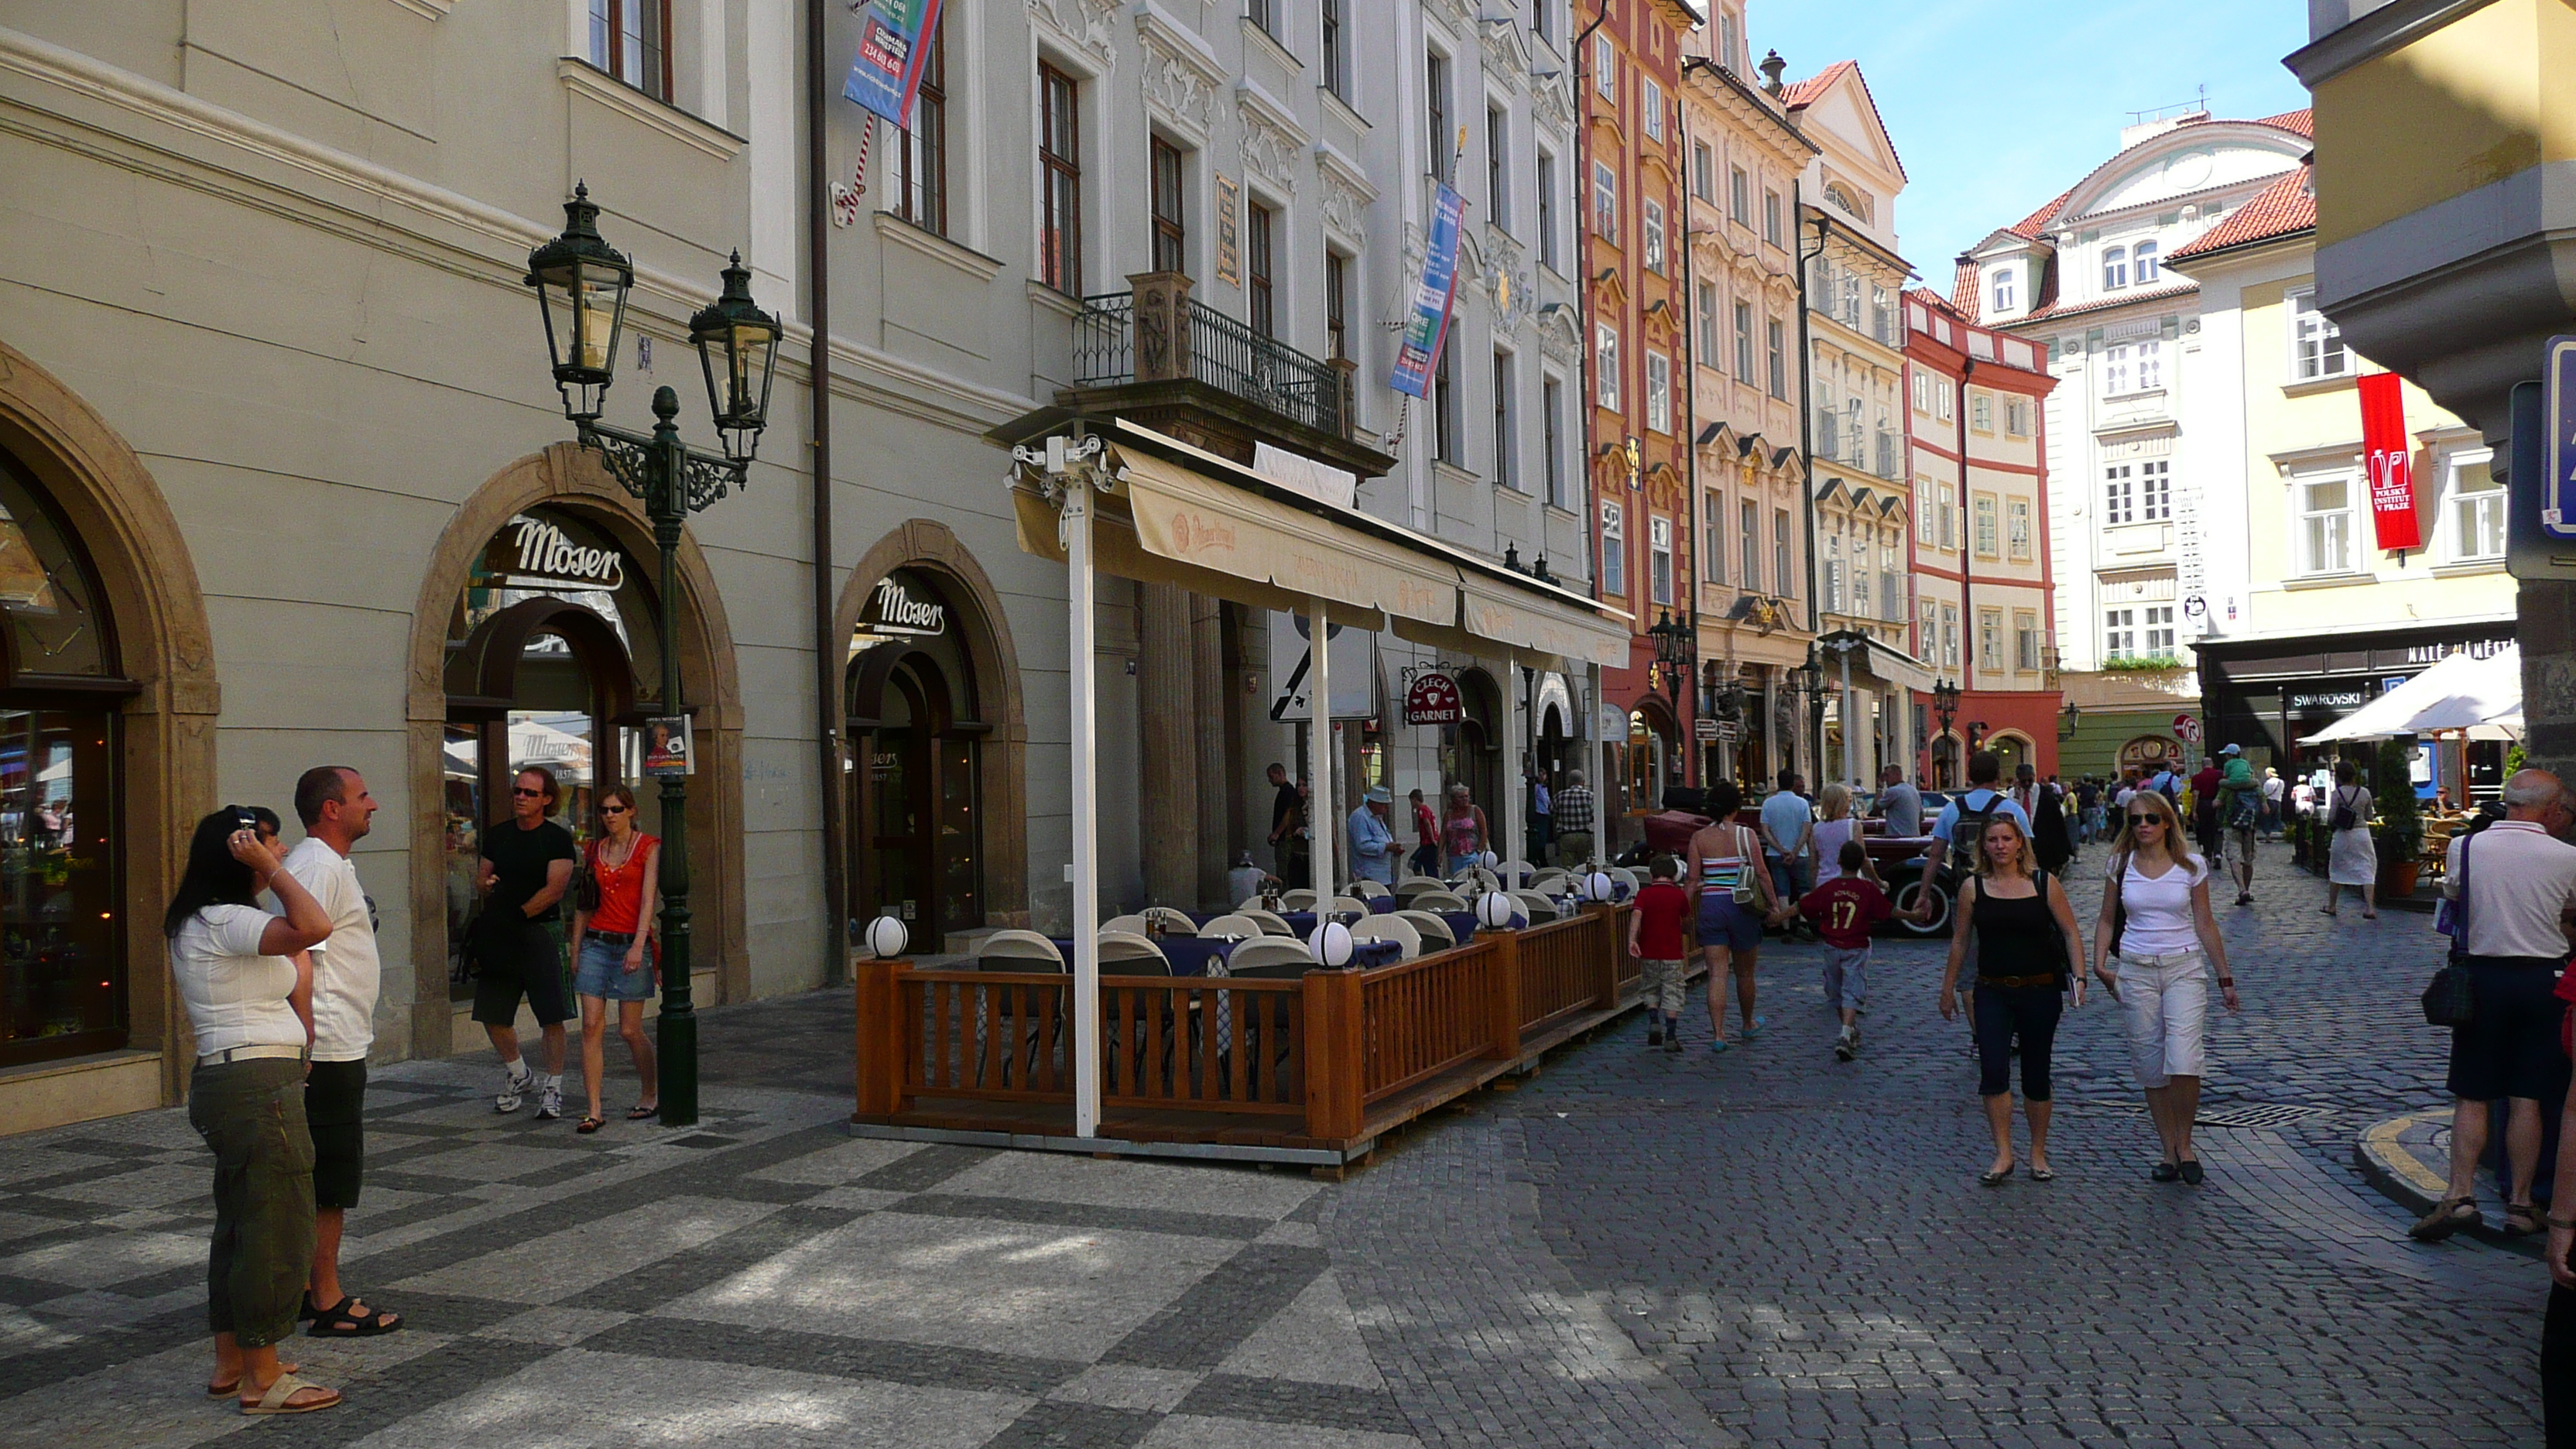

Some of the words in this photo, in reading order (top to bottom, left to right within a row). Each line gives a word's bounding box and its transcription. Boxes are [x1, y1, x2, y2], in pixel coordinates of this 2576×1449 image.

[2375, 487, 2406, 497] POLSKÝ
[2374, 495, 2410, 505] INSTITUT
[2384, 502, 2410, 511] PRAZE
[509, 522, 623, 588] Moser
[875, 585, 944, 632] Moser
[2408, 642, 2444, 663] MALÉ
[1415, 677, 1451, 694] CZECH
[2294, 693, 2360, 706] SWAROVSKI
[1410, 709, 1456, 721] GARNET
[555, 769, 571, 780] 1857
[1832, 901, 1856, 929] 17
